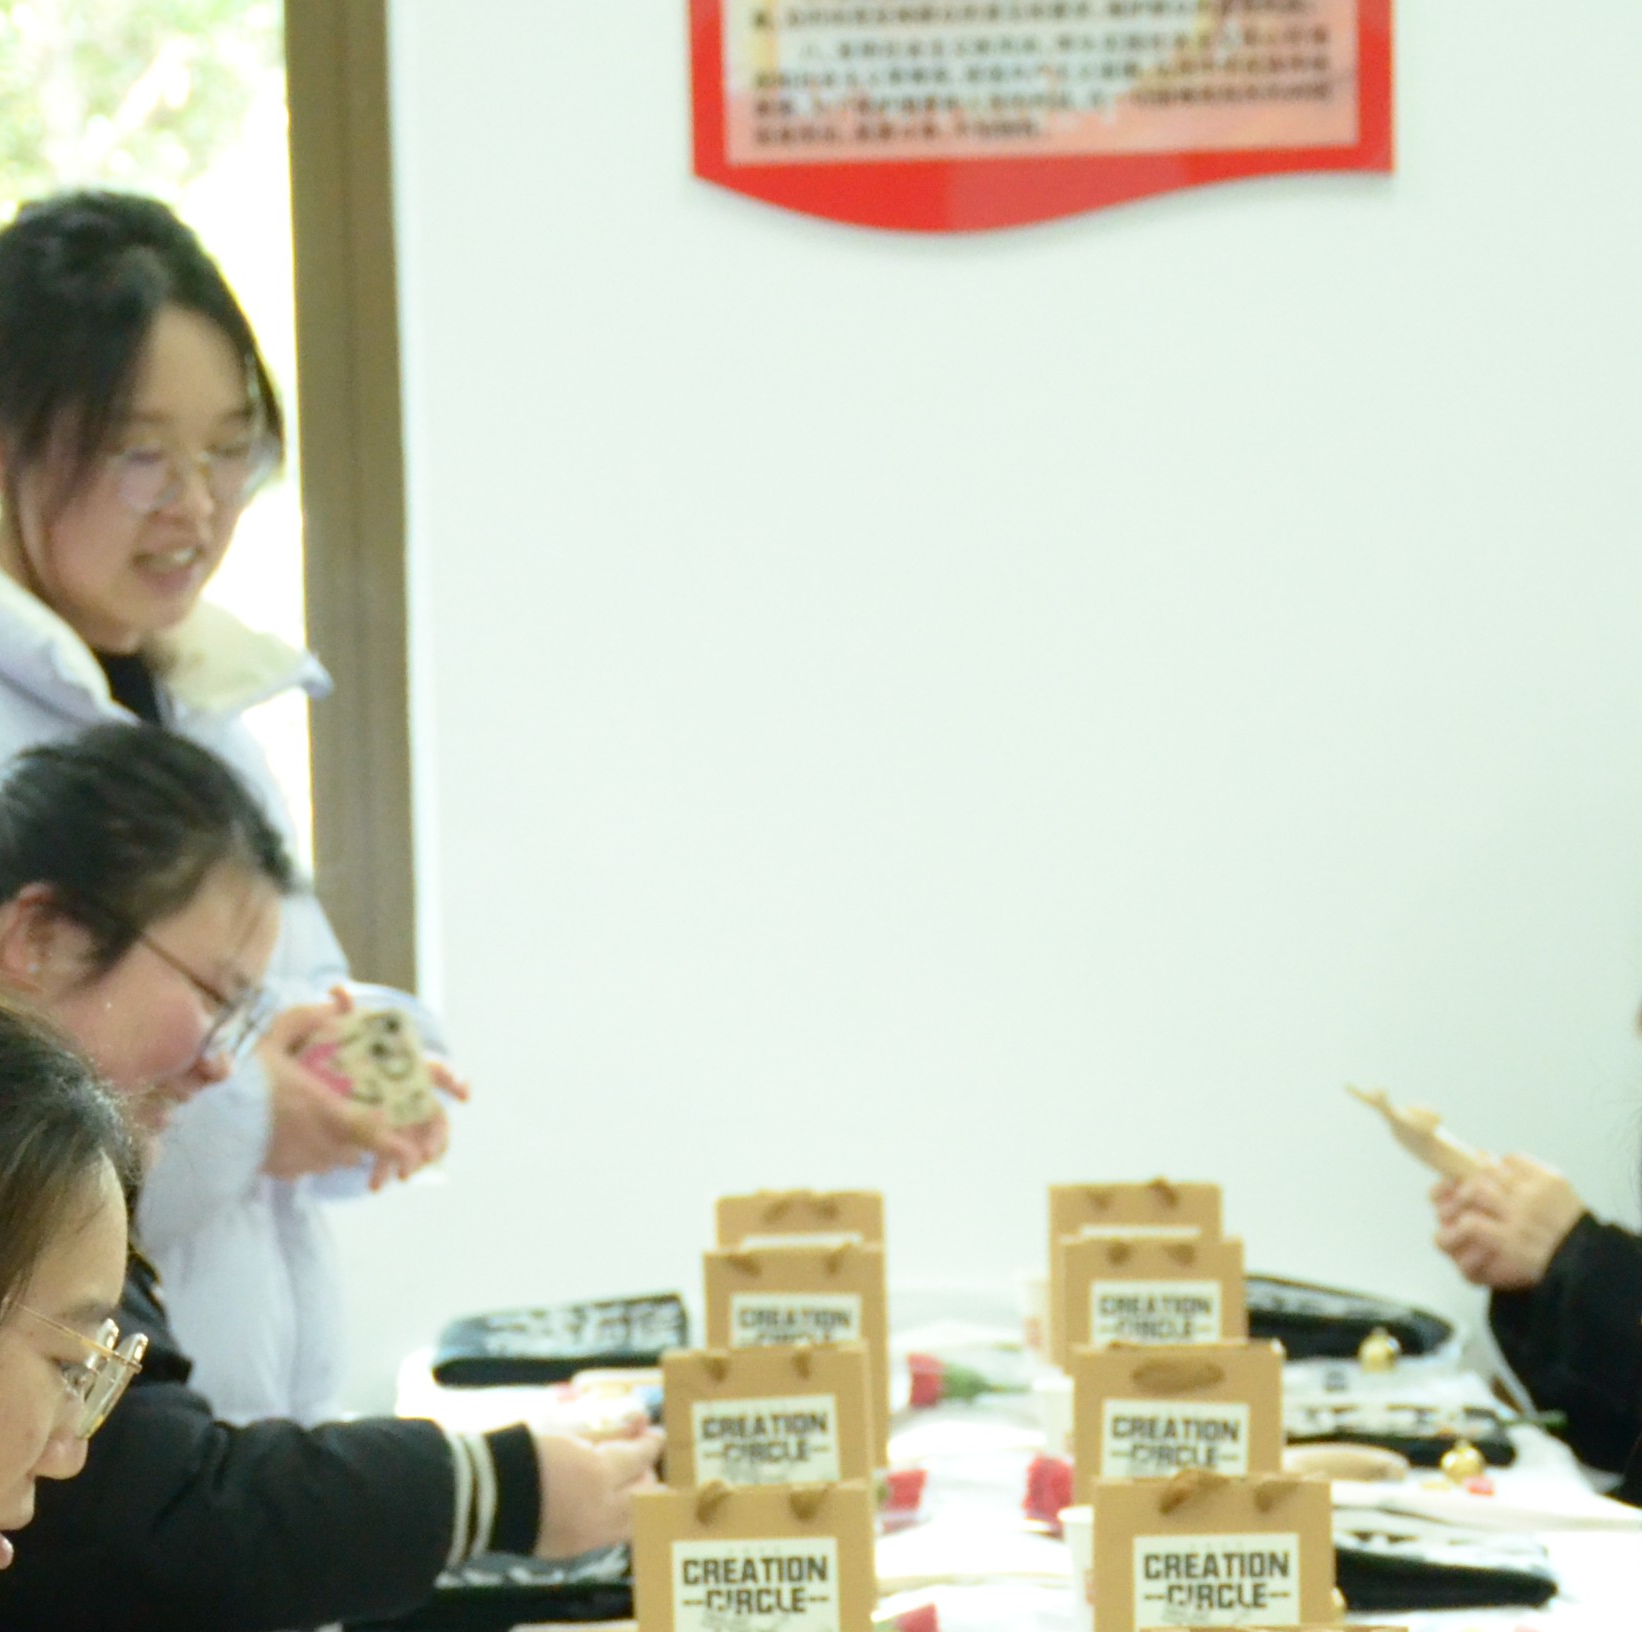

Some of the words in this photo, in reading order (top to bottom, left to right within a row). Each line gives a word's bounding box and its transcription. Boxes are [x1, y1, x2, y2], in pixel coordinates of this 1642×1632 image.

[701, 1412, 828, 1439] CREATION
[1112, 1416, 1240, 1442] CREATION
[683, 1556, 827, 1584] CREATION
[1144, 1552, 1289, 1579] CREATION
